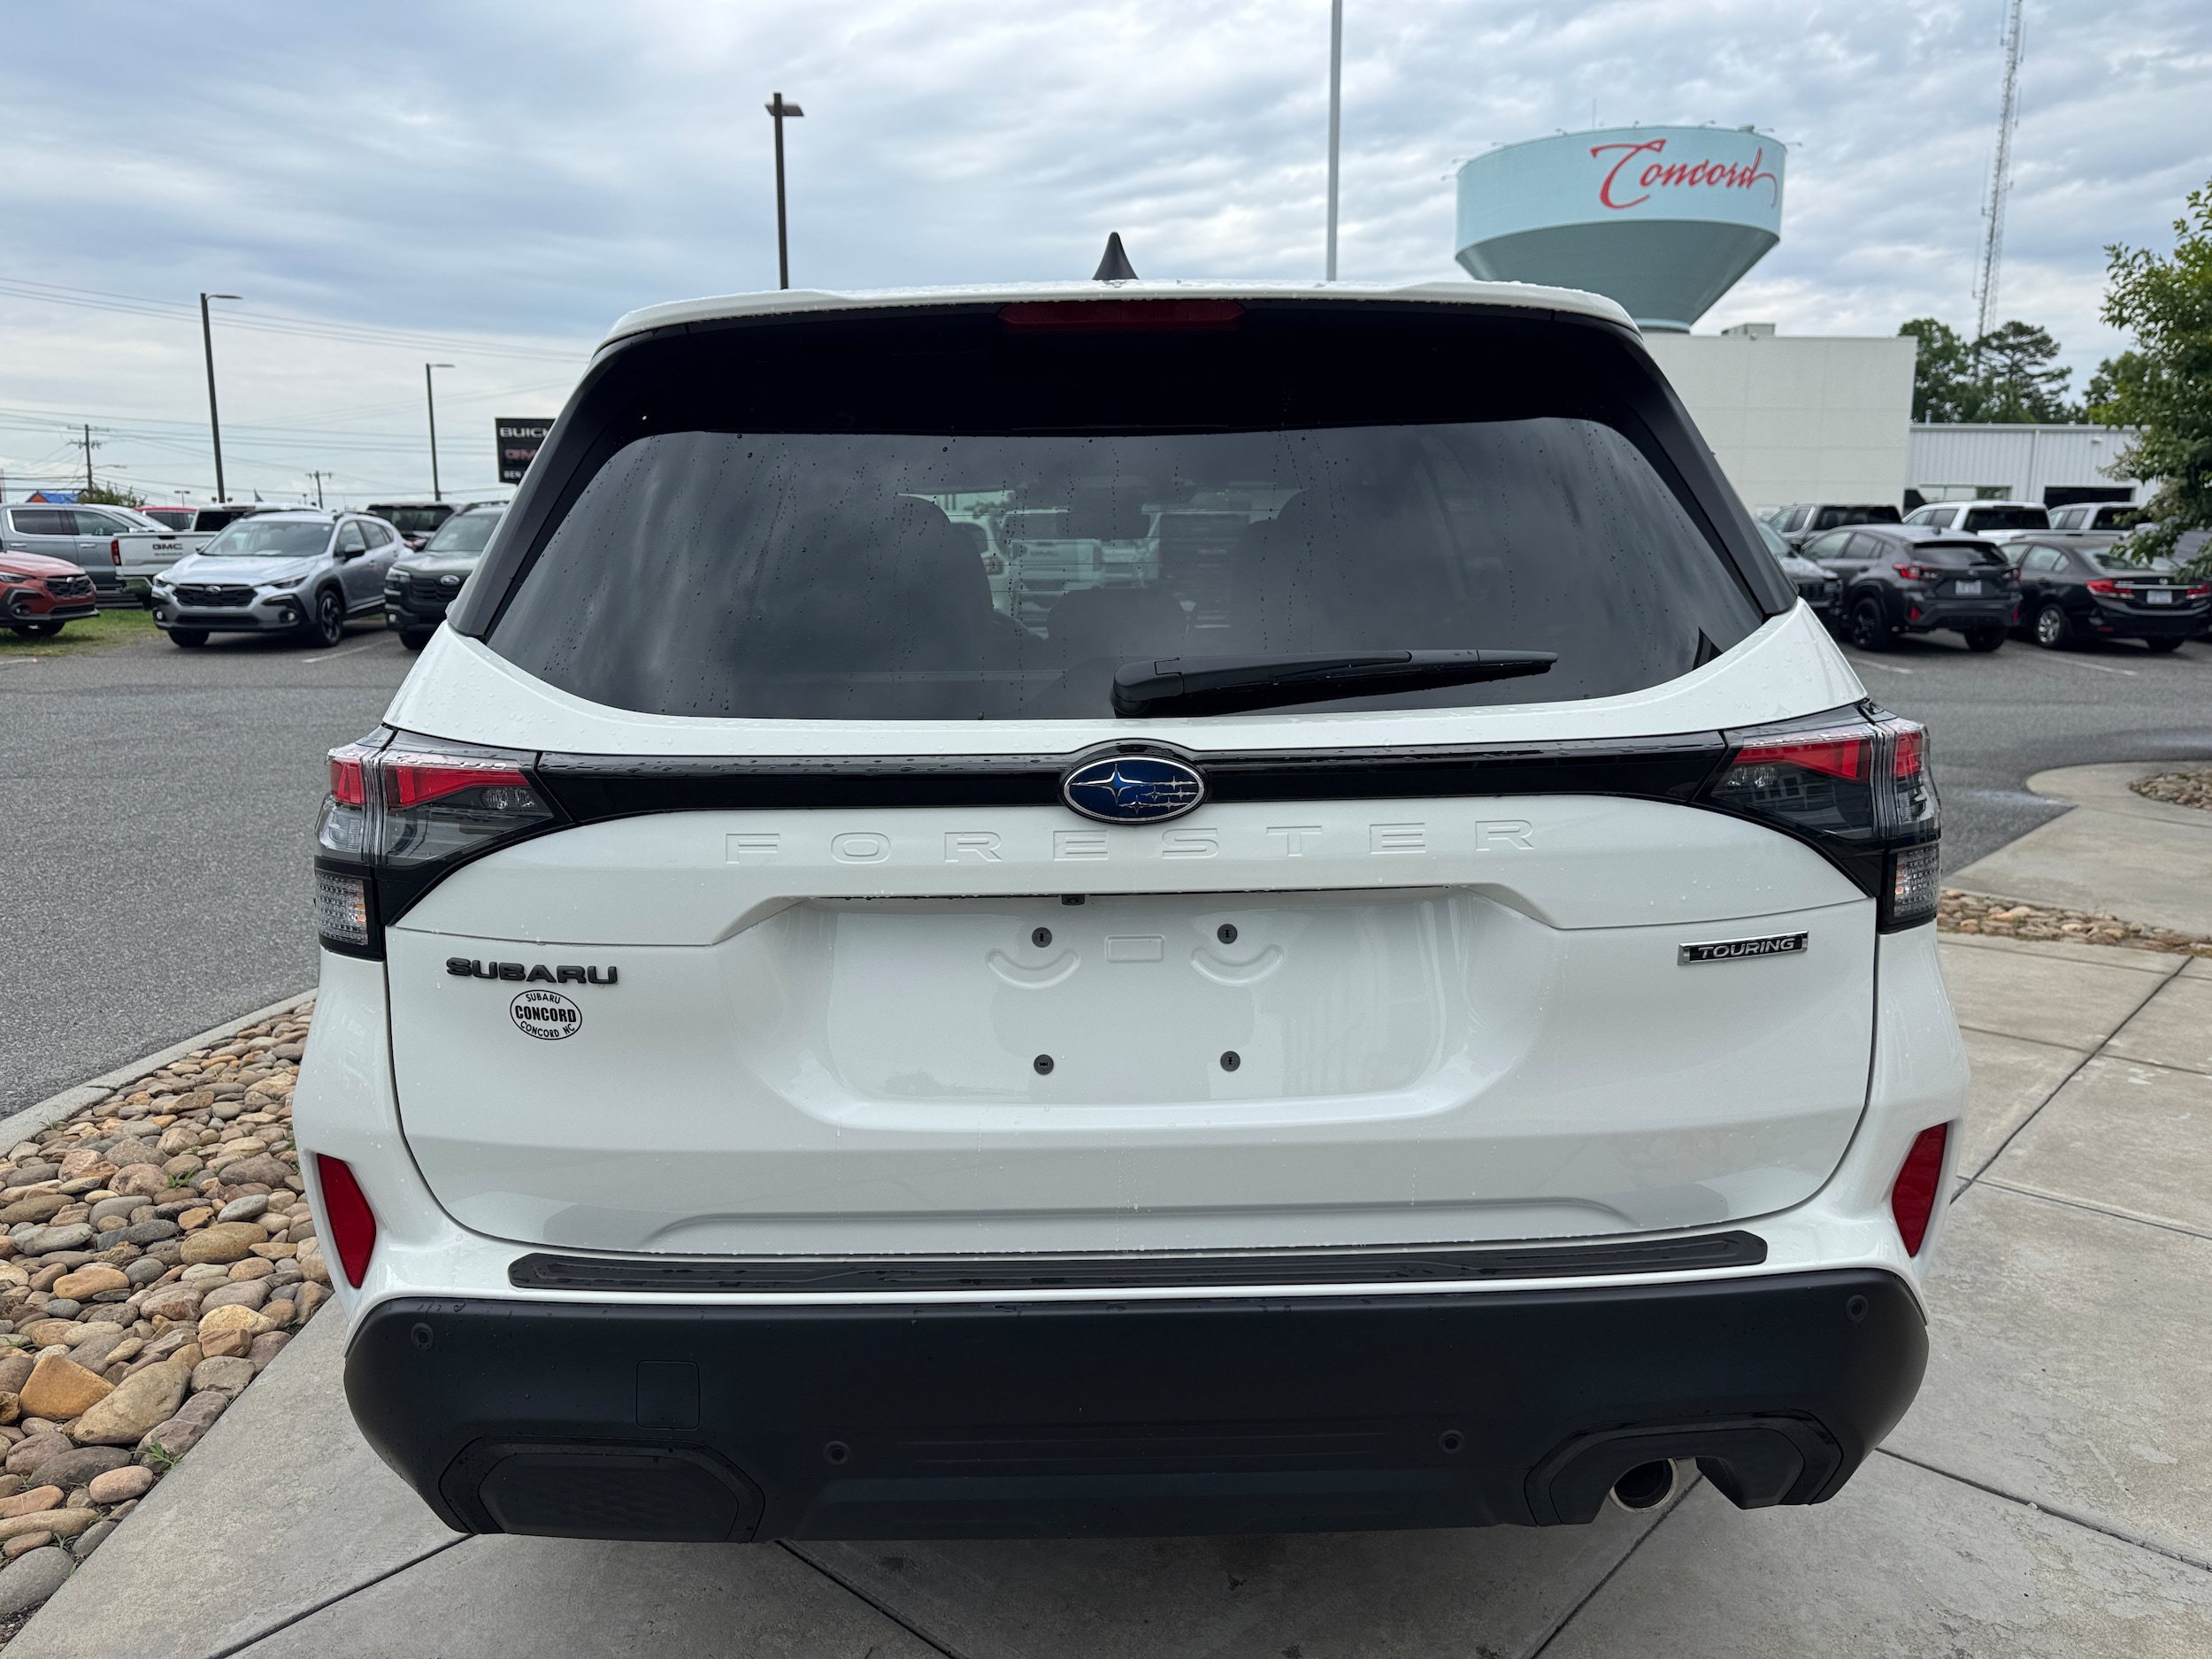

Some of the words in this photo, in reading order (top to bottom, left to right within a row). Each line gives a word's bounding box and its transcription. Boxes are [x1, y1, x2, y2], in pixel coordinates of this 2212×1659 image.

[504, 449, 538, 460] GM
[725, 819, 1535, 864] FORESTER
[1698, 938, 1795, 958] TOURING
[446, 957, 618, 985] SUBARU
[526, 993, 561, 1004] SUBARU
[515, 1005, 577, 1023] CONCORD
[520, 1020, 560, 1038] CONCORD
[562, 1023, 575, 1035] NC
